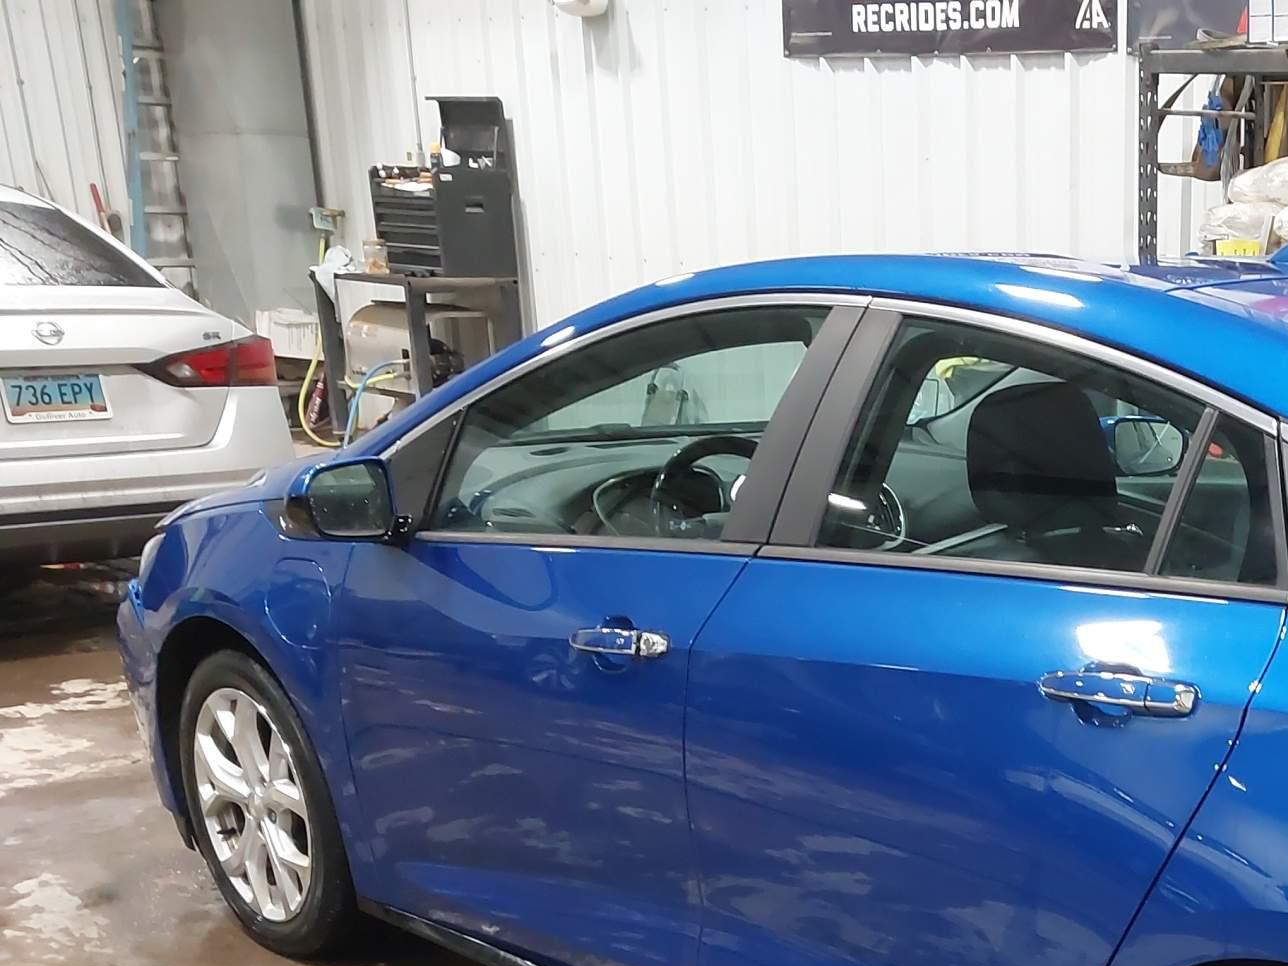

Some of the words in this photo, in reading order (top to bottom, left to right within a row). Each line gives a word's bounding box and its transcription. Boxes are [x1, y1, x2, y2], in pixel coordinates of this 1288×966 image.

[852, 0, 1020, 32] RECRIDES.COM
[10, 384, 53, 407] 736
[57, 382, 95, 405] EPY
